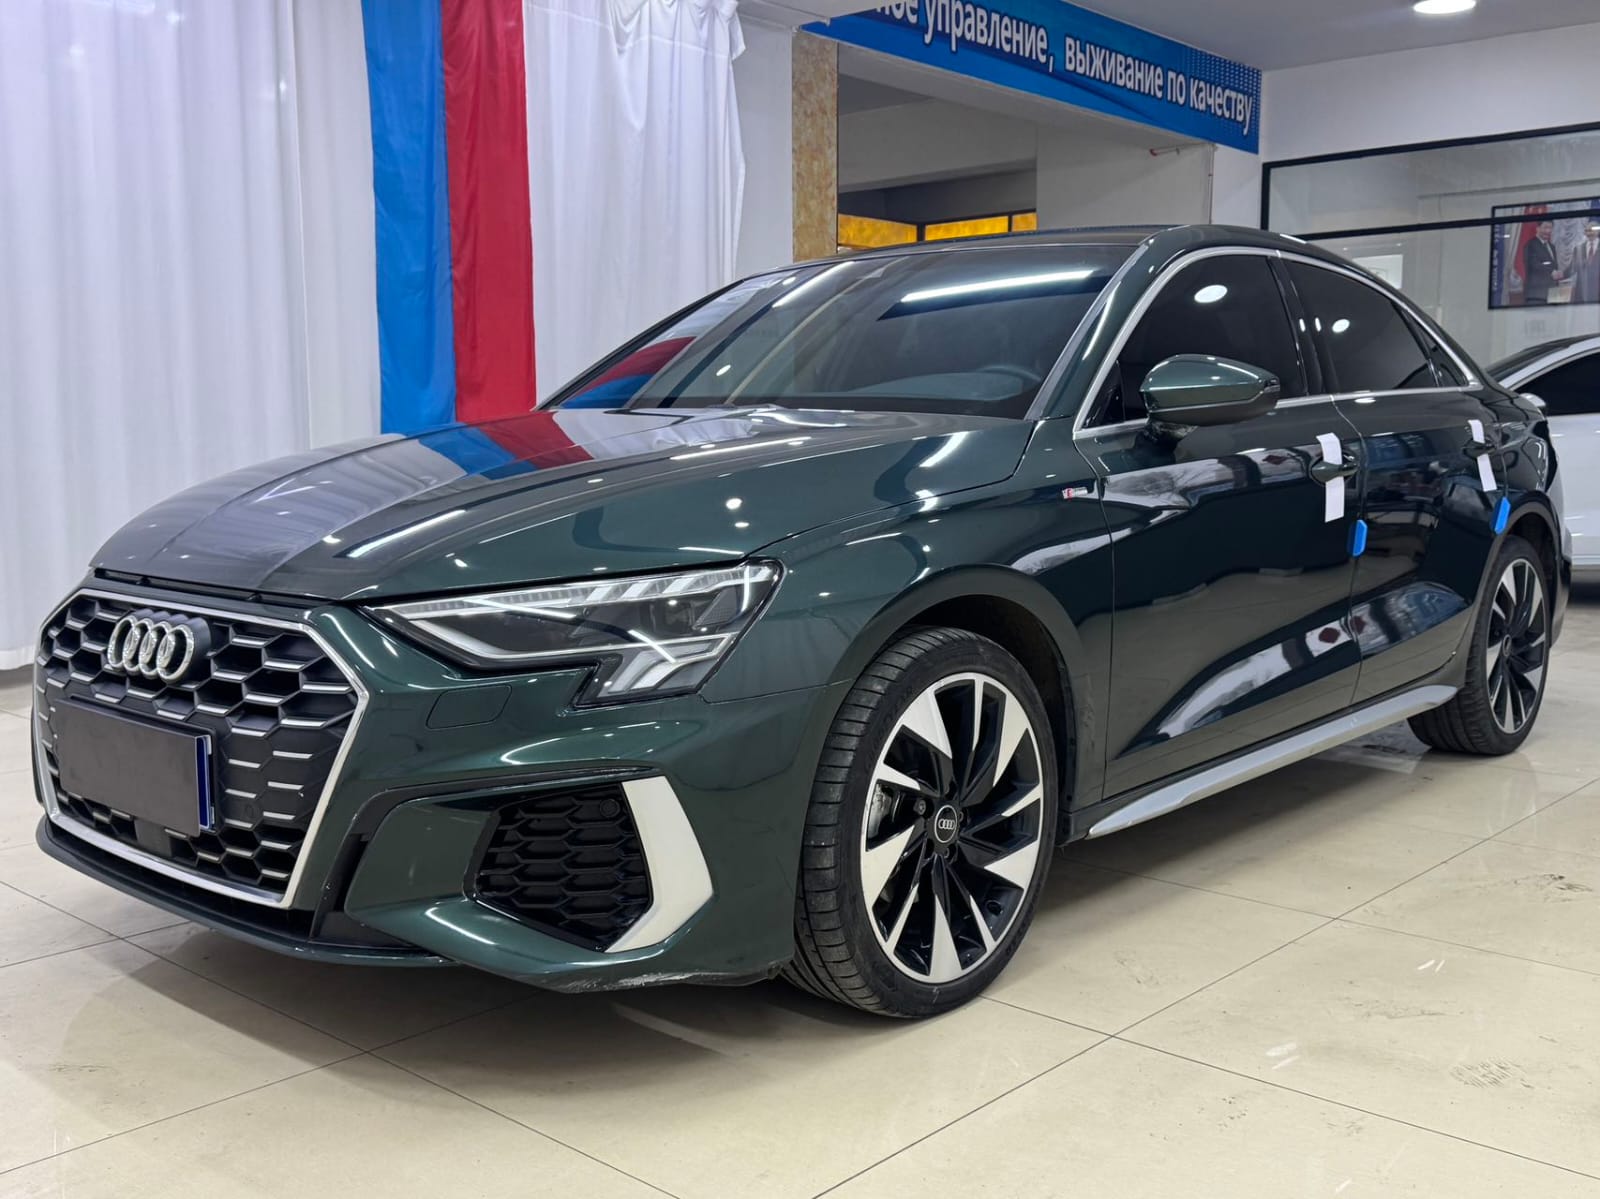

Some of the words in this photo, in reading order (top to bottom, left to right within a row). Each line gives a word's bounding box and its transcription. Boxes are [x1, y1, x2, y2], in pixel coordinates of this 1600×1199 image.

[876, 0, 918, 24] ое
[924, 0, 1054, 73] управление,
[1065, 37, 1163, 98] выживание
[1167, 71, 1185, 105] по
[1190, 78, 1252, 135] качеству
